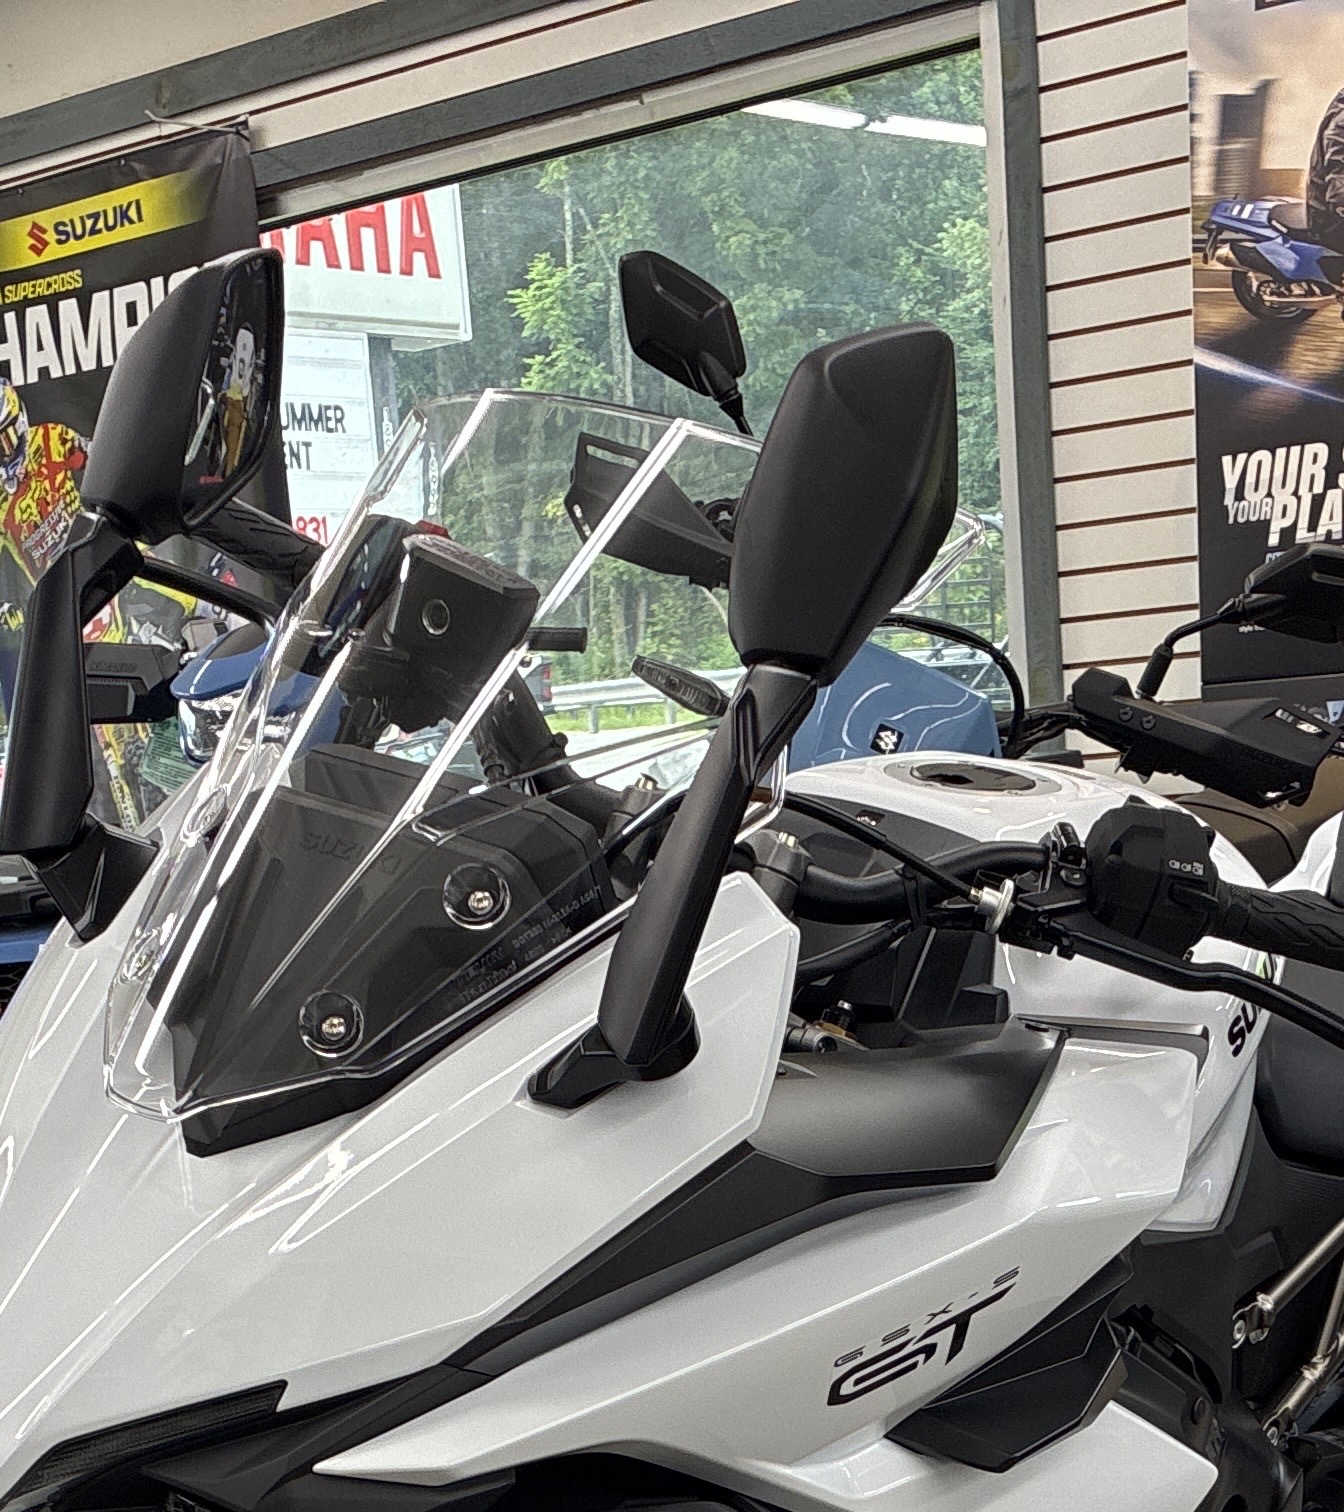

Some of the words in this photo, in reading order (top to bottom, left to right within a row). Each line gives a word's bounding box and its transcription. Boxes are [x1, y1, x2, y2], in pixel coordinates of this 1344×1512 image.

[53, 199, 144, 245] SUZUKI
[4, 270, 82, 304] SUPERCROSS
[1221, 442, 1329, 506] YOUR
[1227, 500, 1272, 524] YOUR
[1227, 1002, 1263, 1058] SU
[826, 1282, 1017, 1407] GT
[833, 1265, 1020, 1368] GSX-S
